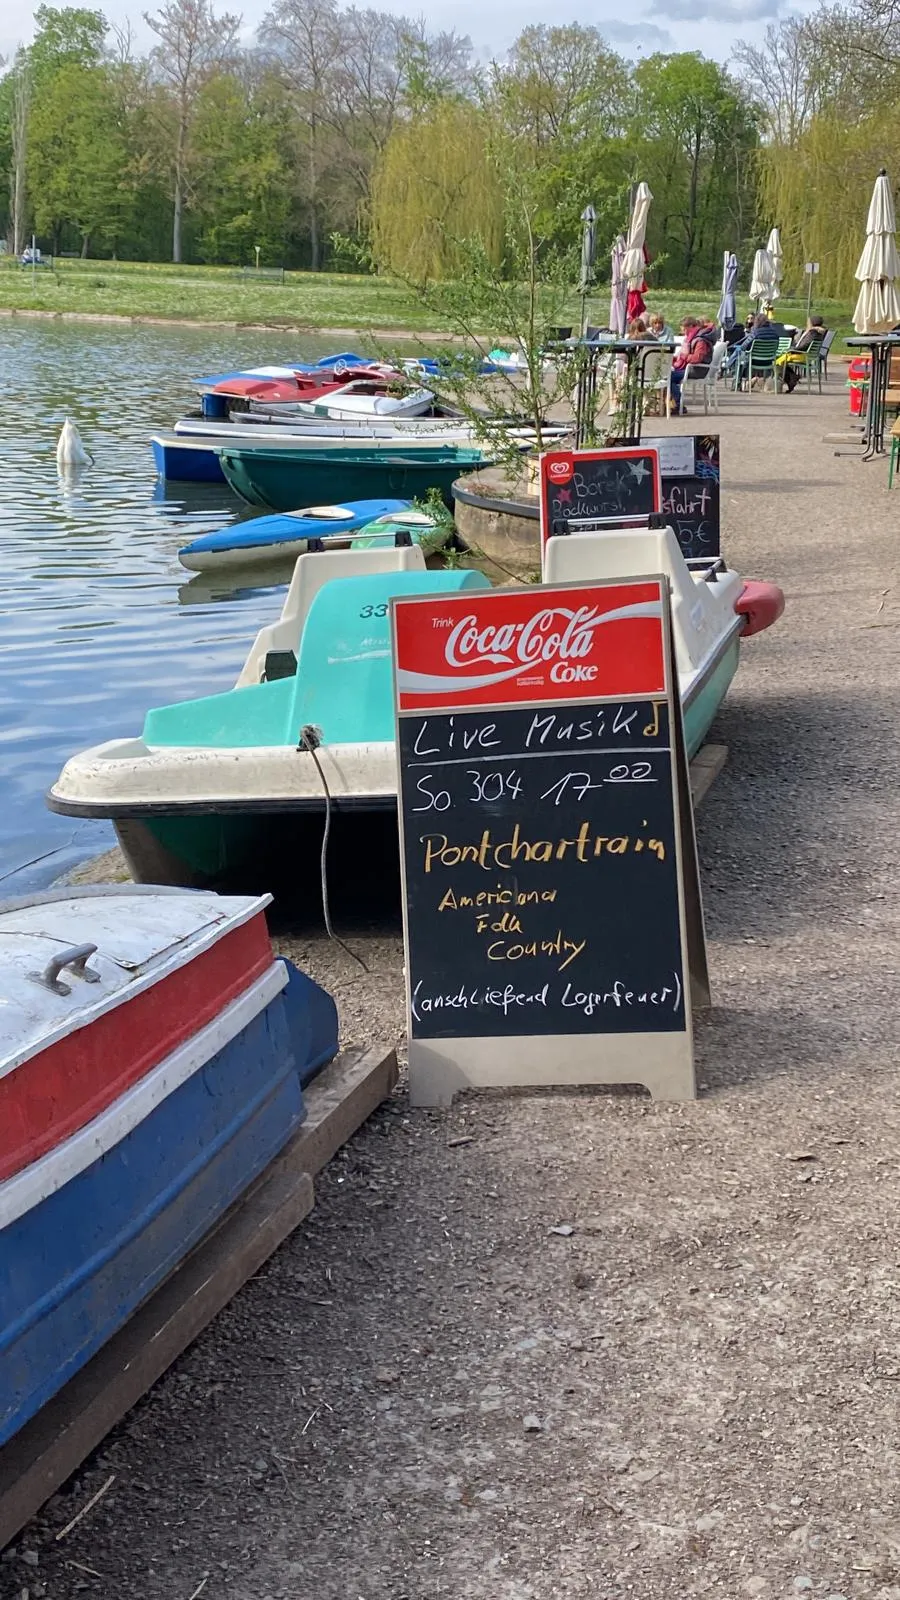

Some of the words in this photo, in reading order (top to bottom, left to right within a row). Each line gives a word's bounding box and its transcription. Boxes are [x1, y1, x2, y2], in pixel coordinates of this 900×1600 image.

[661, 486, 711, 516] sfahrt
[359, 603, 388, 618] 33
[431, 617, 455, 629] Trink
[445, 604, 599, 668] Coca-Cola
[550, 661, 599, 683] Coke
[414, 716, 501, 755] Live
[525, 705, 638, 748] Musik
[420, 820, 666, 873] Pontchartrain
[438, 884, 557, 912] Americana
[487, 930, 586, 971] Country
